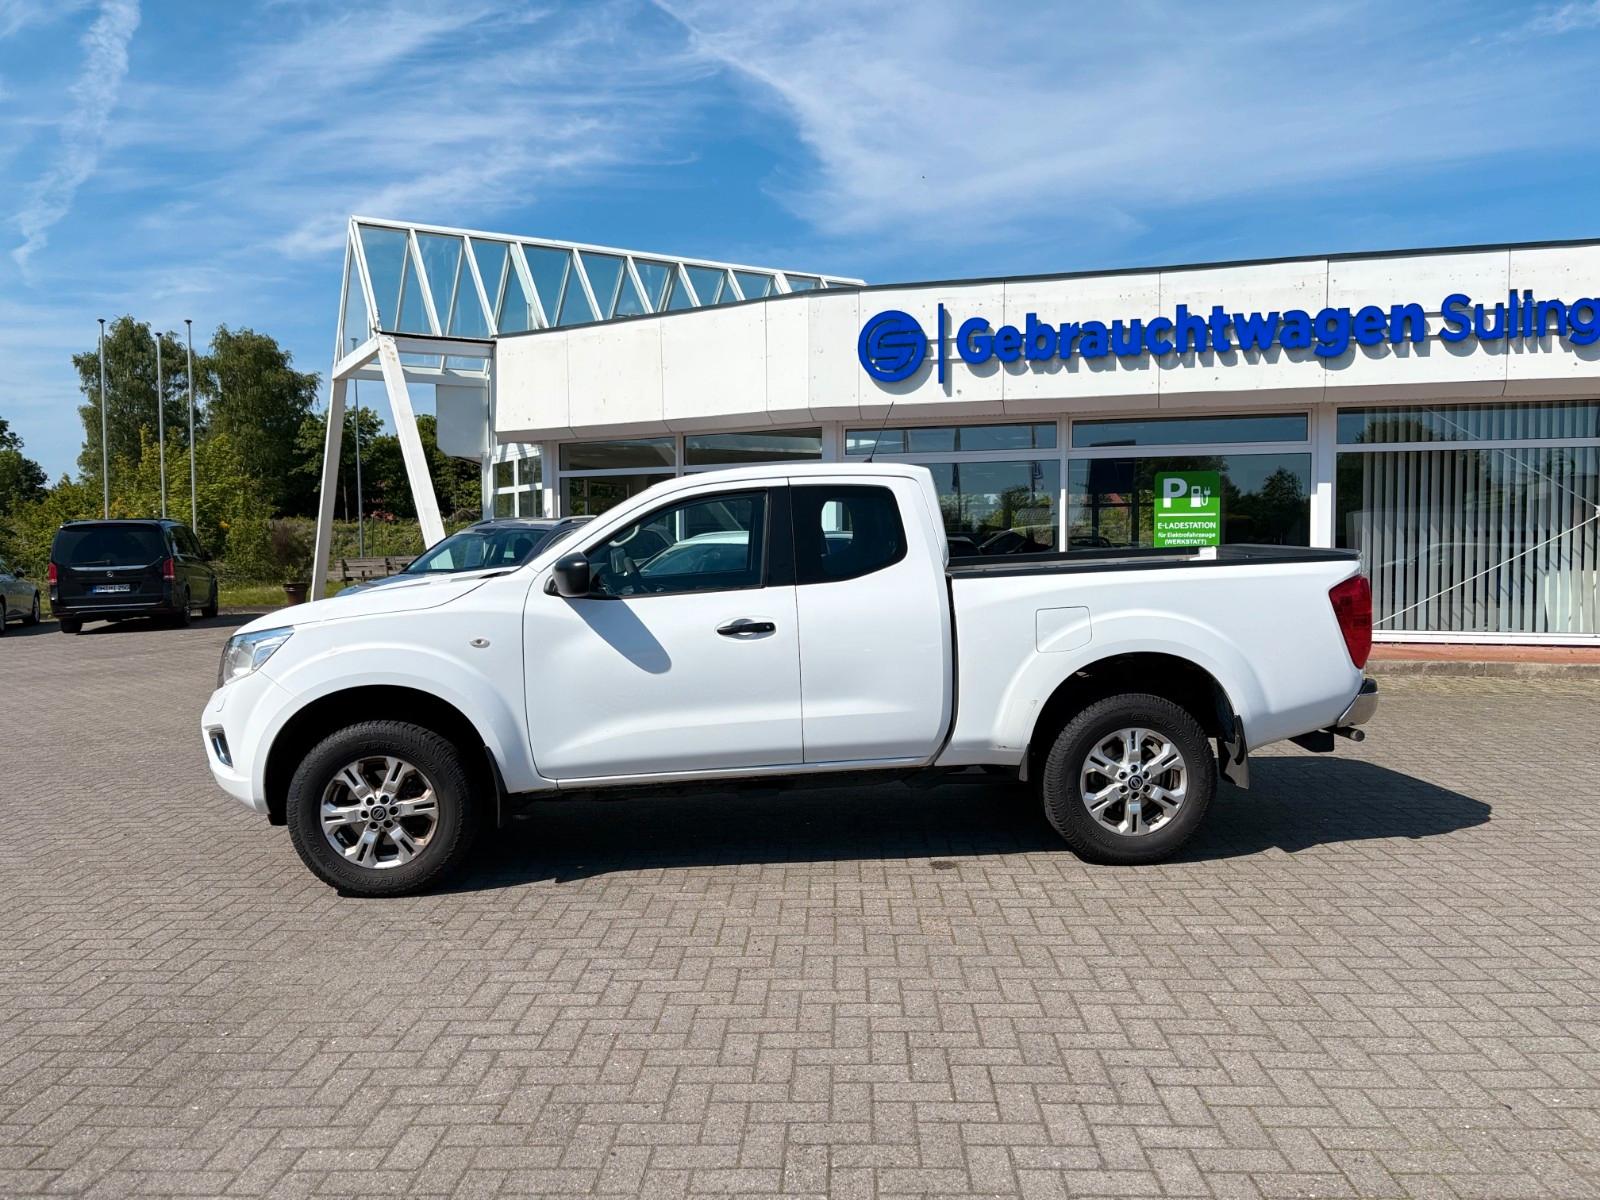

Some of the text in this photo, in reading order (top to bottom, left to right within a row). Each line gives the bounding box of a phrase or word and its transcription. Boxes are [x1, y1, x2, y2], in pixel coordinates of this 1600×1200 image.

[957, 289, 1600, 365] Gebrauchtwagen Suling
[1163, 478, 1187, 508] P
[1157, 521, 1216, 529] E-LADESTATION
[1167, 531, 1216, 539] Elektrofahrzeuge
